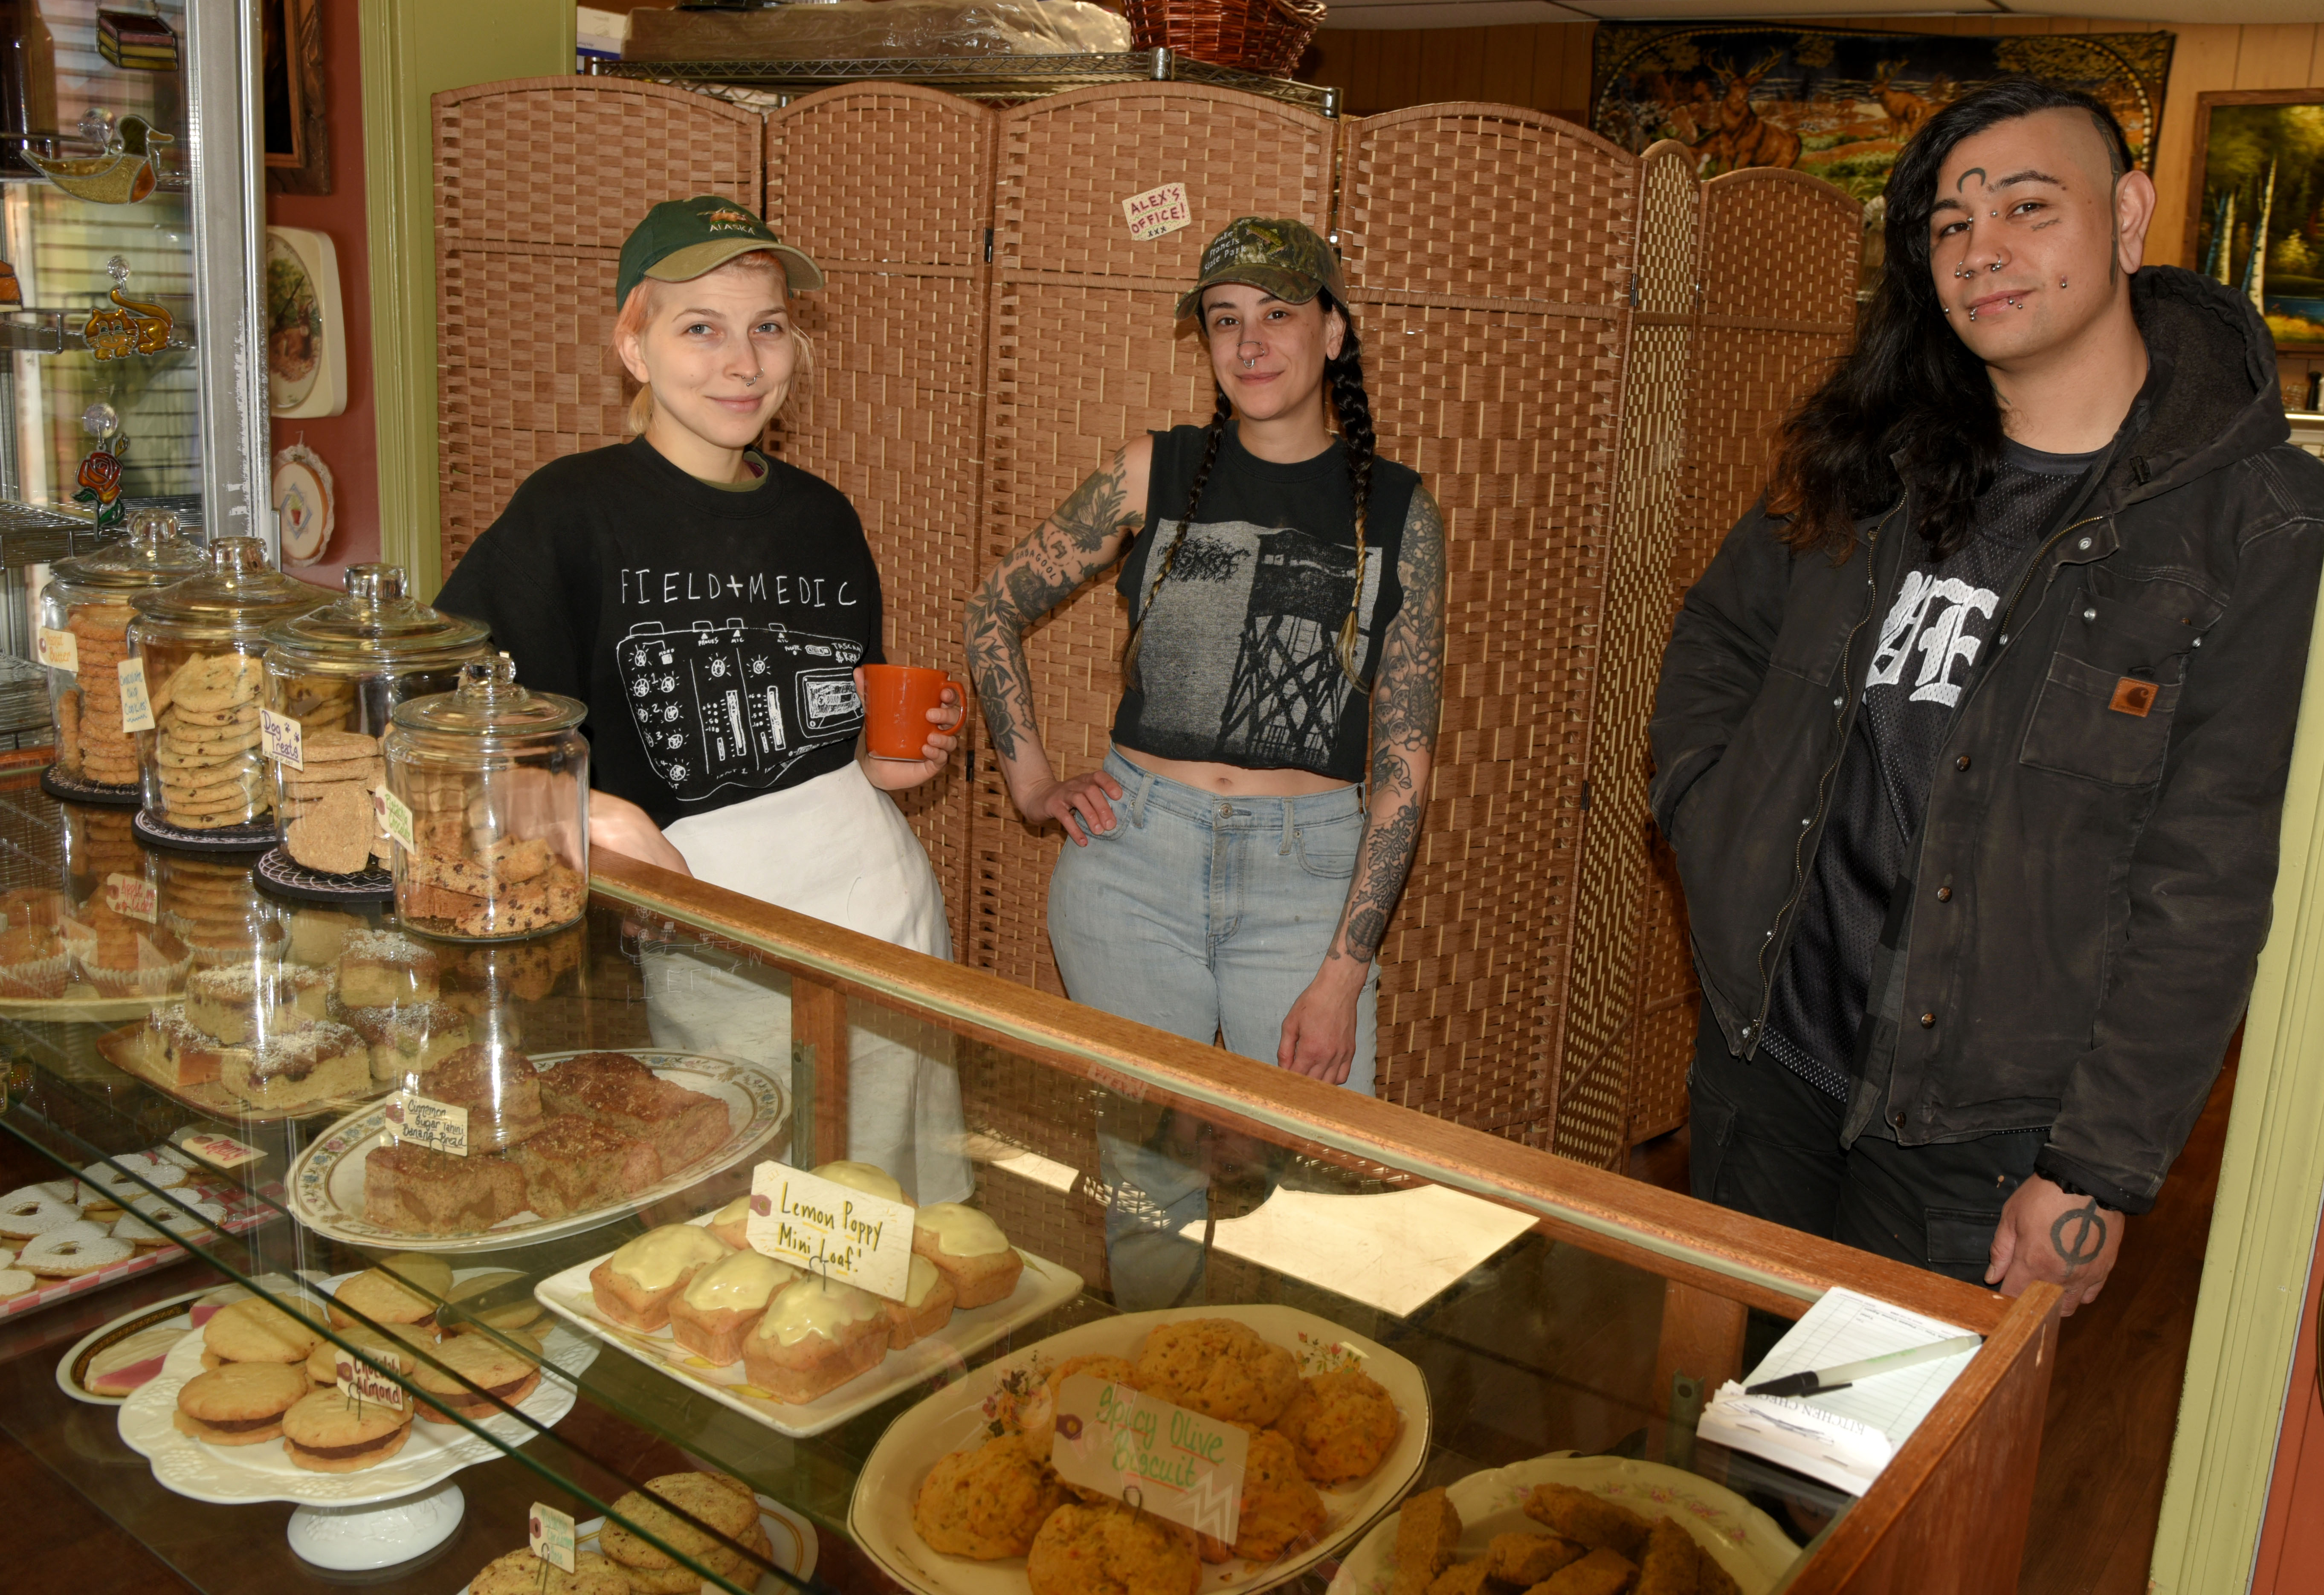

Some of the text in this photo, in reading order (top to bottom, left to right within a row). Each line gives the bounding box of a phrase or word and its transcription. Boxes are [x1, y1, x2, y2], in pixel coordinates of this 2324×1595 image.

[1130, 187, 1180, 215] ALEX'S
[710, 223, 756, 236] ALASKA
[1131, 202, 1185, 233] OFFICE!
[1209, 238, 1240, 259] Francis
[1214, 231, 1233, 245] Lake
[1224, 244, 1246, 258] Park
[1015, 548, 1057, 580] GABAGOOL
[49, 646, 72, 663] Butter
[651, 672, 659, 684] 1
[652, 703, 660, 713] 2
[261, 710, 281, 741] Dog
[655, 731, 663, 740] 3
[265, 730, 299, 759] Treats
[121, 877, 143, 901] Apple
[407, 1098, 447, 1116] Cinnamon
[402, 1123, 467, 1147] Banana Bread
[415, 1114, 464, 1136] Sugar Tahini
[780, 1181, 883, 1252] Lemon Poppy
[778, 1222, 862, 1273] Mini Loaf!
[356, 1375, 402, 1406] Almond
[1096, 1386, 1225, 1463] Spicy Olive
[1802, 1406, 1866, 1436] KITCHEN
[1112, 1427, 1197, 1488] Biscuit
